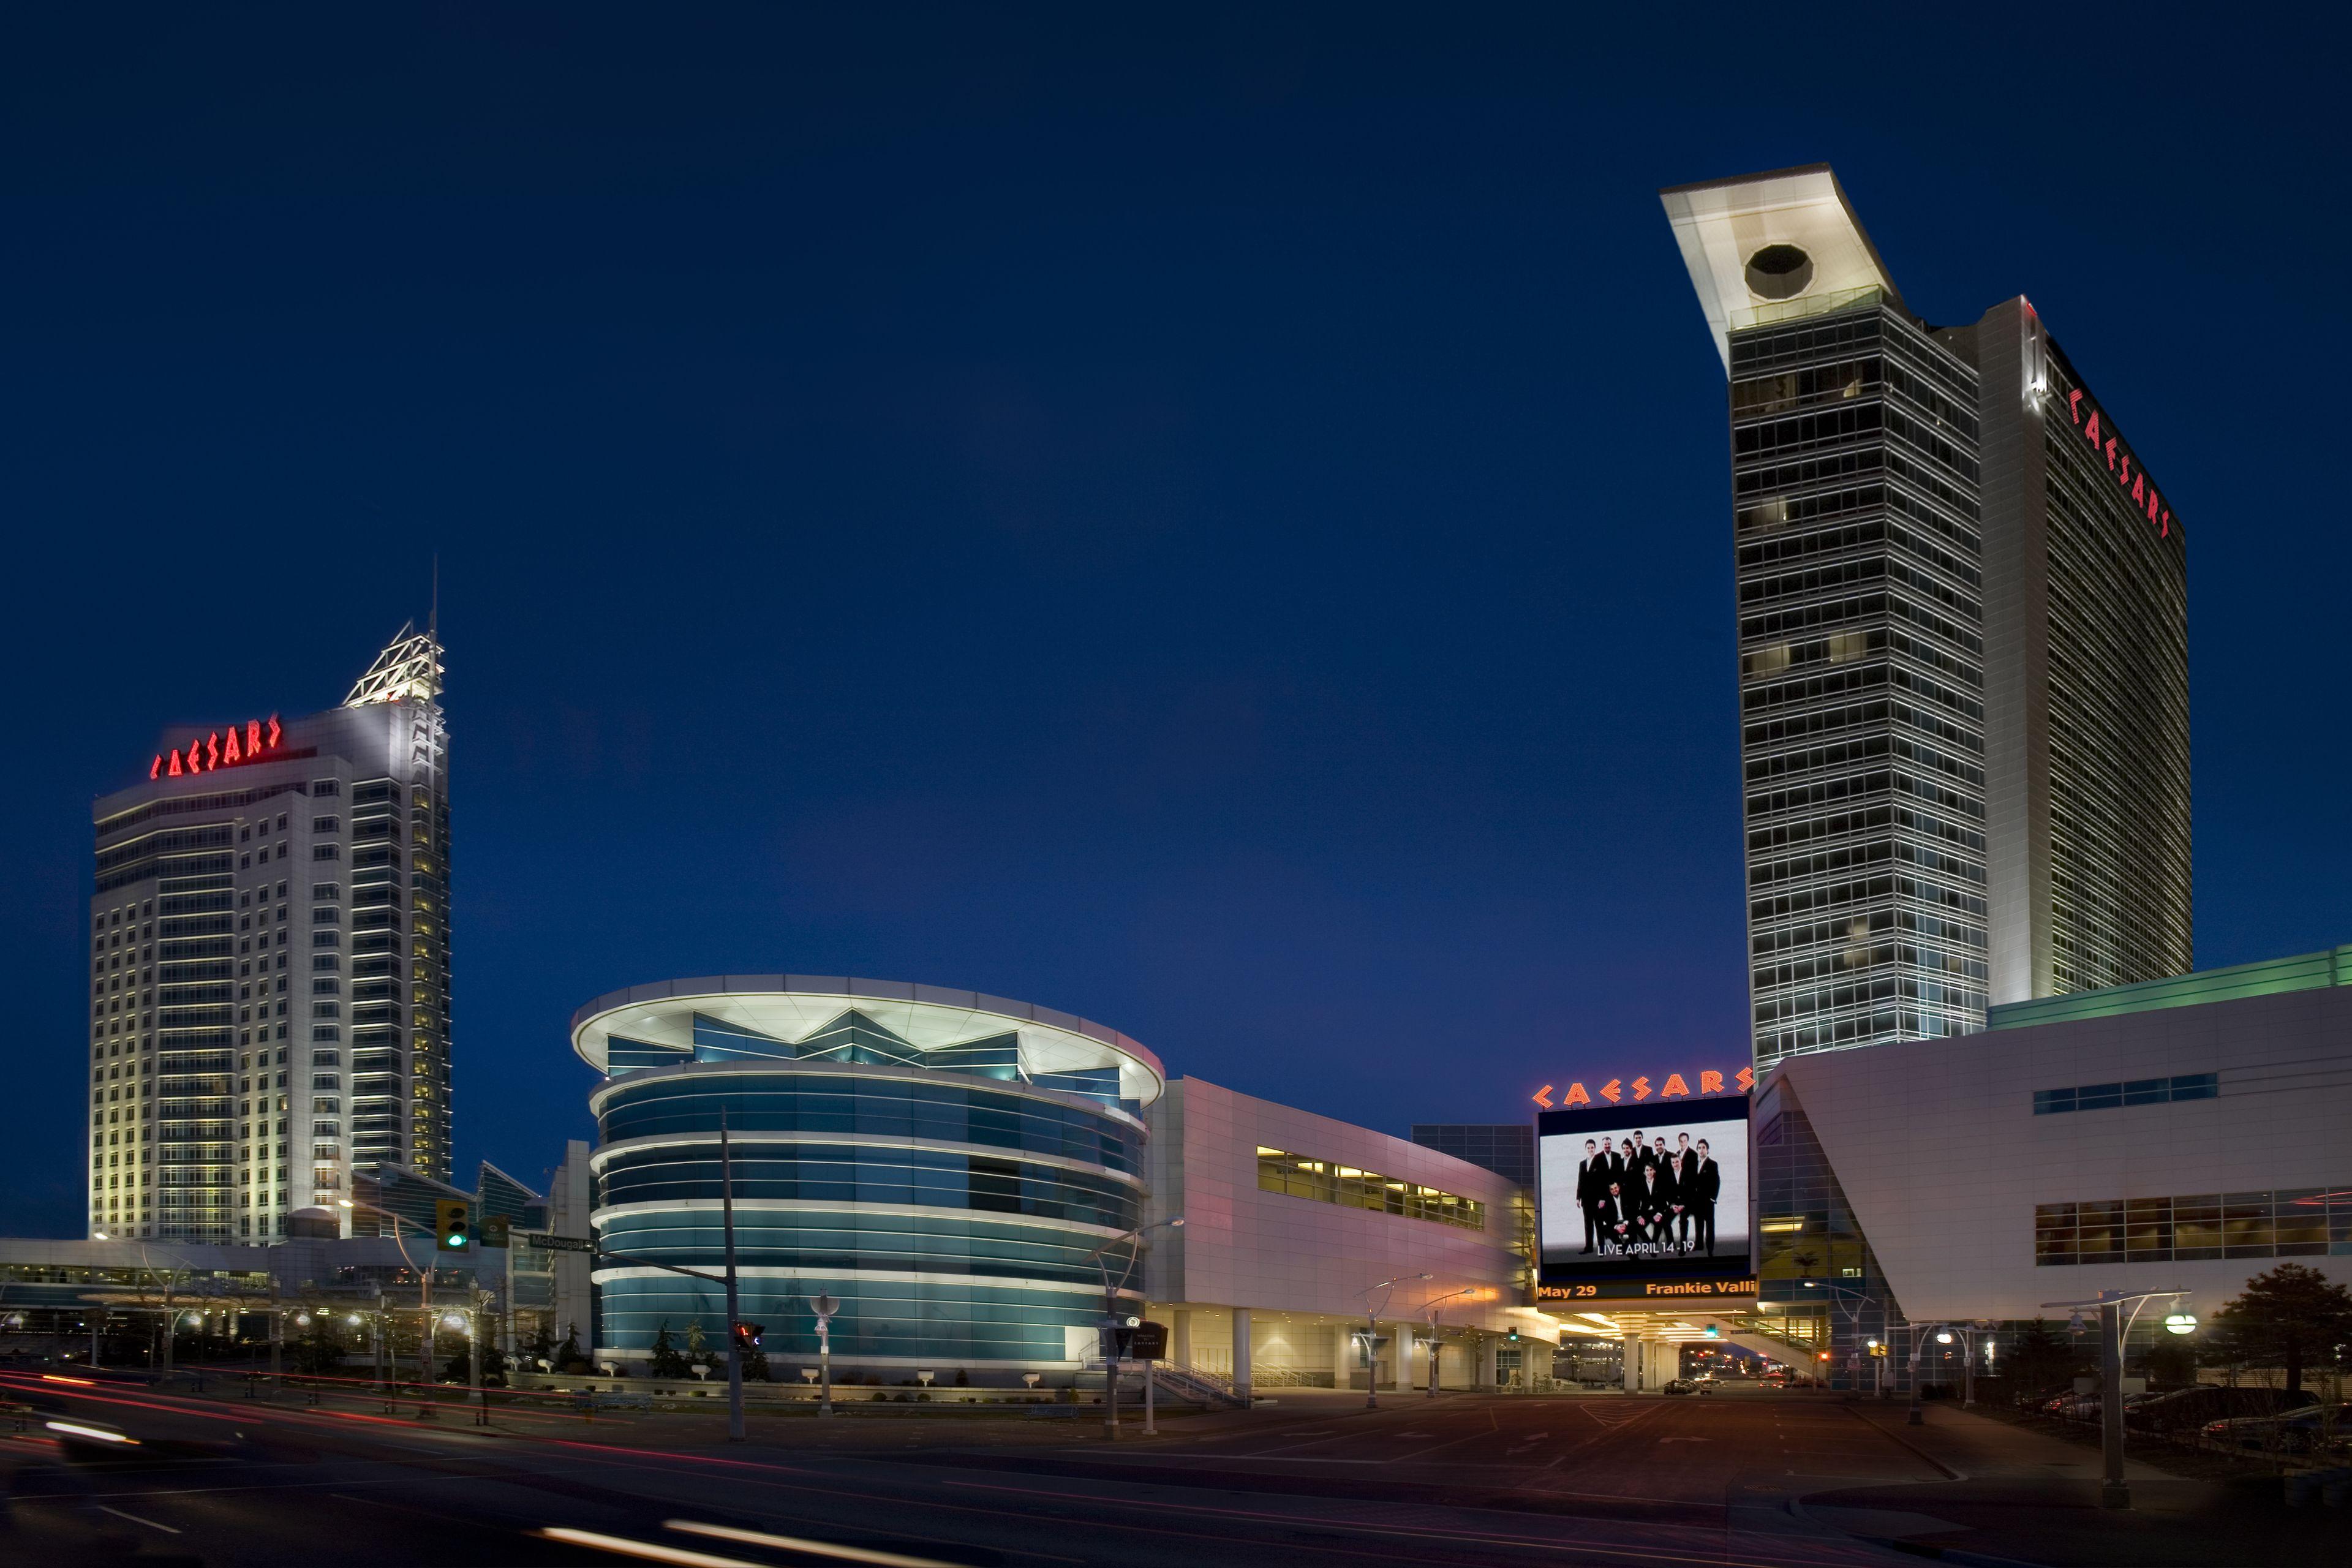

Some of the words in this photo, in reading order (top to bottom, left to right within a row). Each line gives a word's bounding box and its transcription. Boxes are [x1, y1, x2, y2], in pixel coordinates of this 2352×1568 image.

[2069, 388, 2169, 538] CAESARS
[150, 712, 281, 779] CAESARS
[1532, 1067, 1756, 1108] CAESARS
[532, 1235, 583, 1250] McDougall
[1597, 1245, 1623, 1256] LIVE
[1626, 1242, 1659, 1254] APRIL
[1662, 1242, 1674, 1253] 14
[1683, 1240, 1695, 1251] 19
[1538, 1287, 1571, 1298] May
[1577, 1286, 1597, 1296] 29
[1646, 1283, 1711, 1294] Frankie
[1716, 1281, 1755, 1292] Valli
